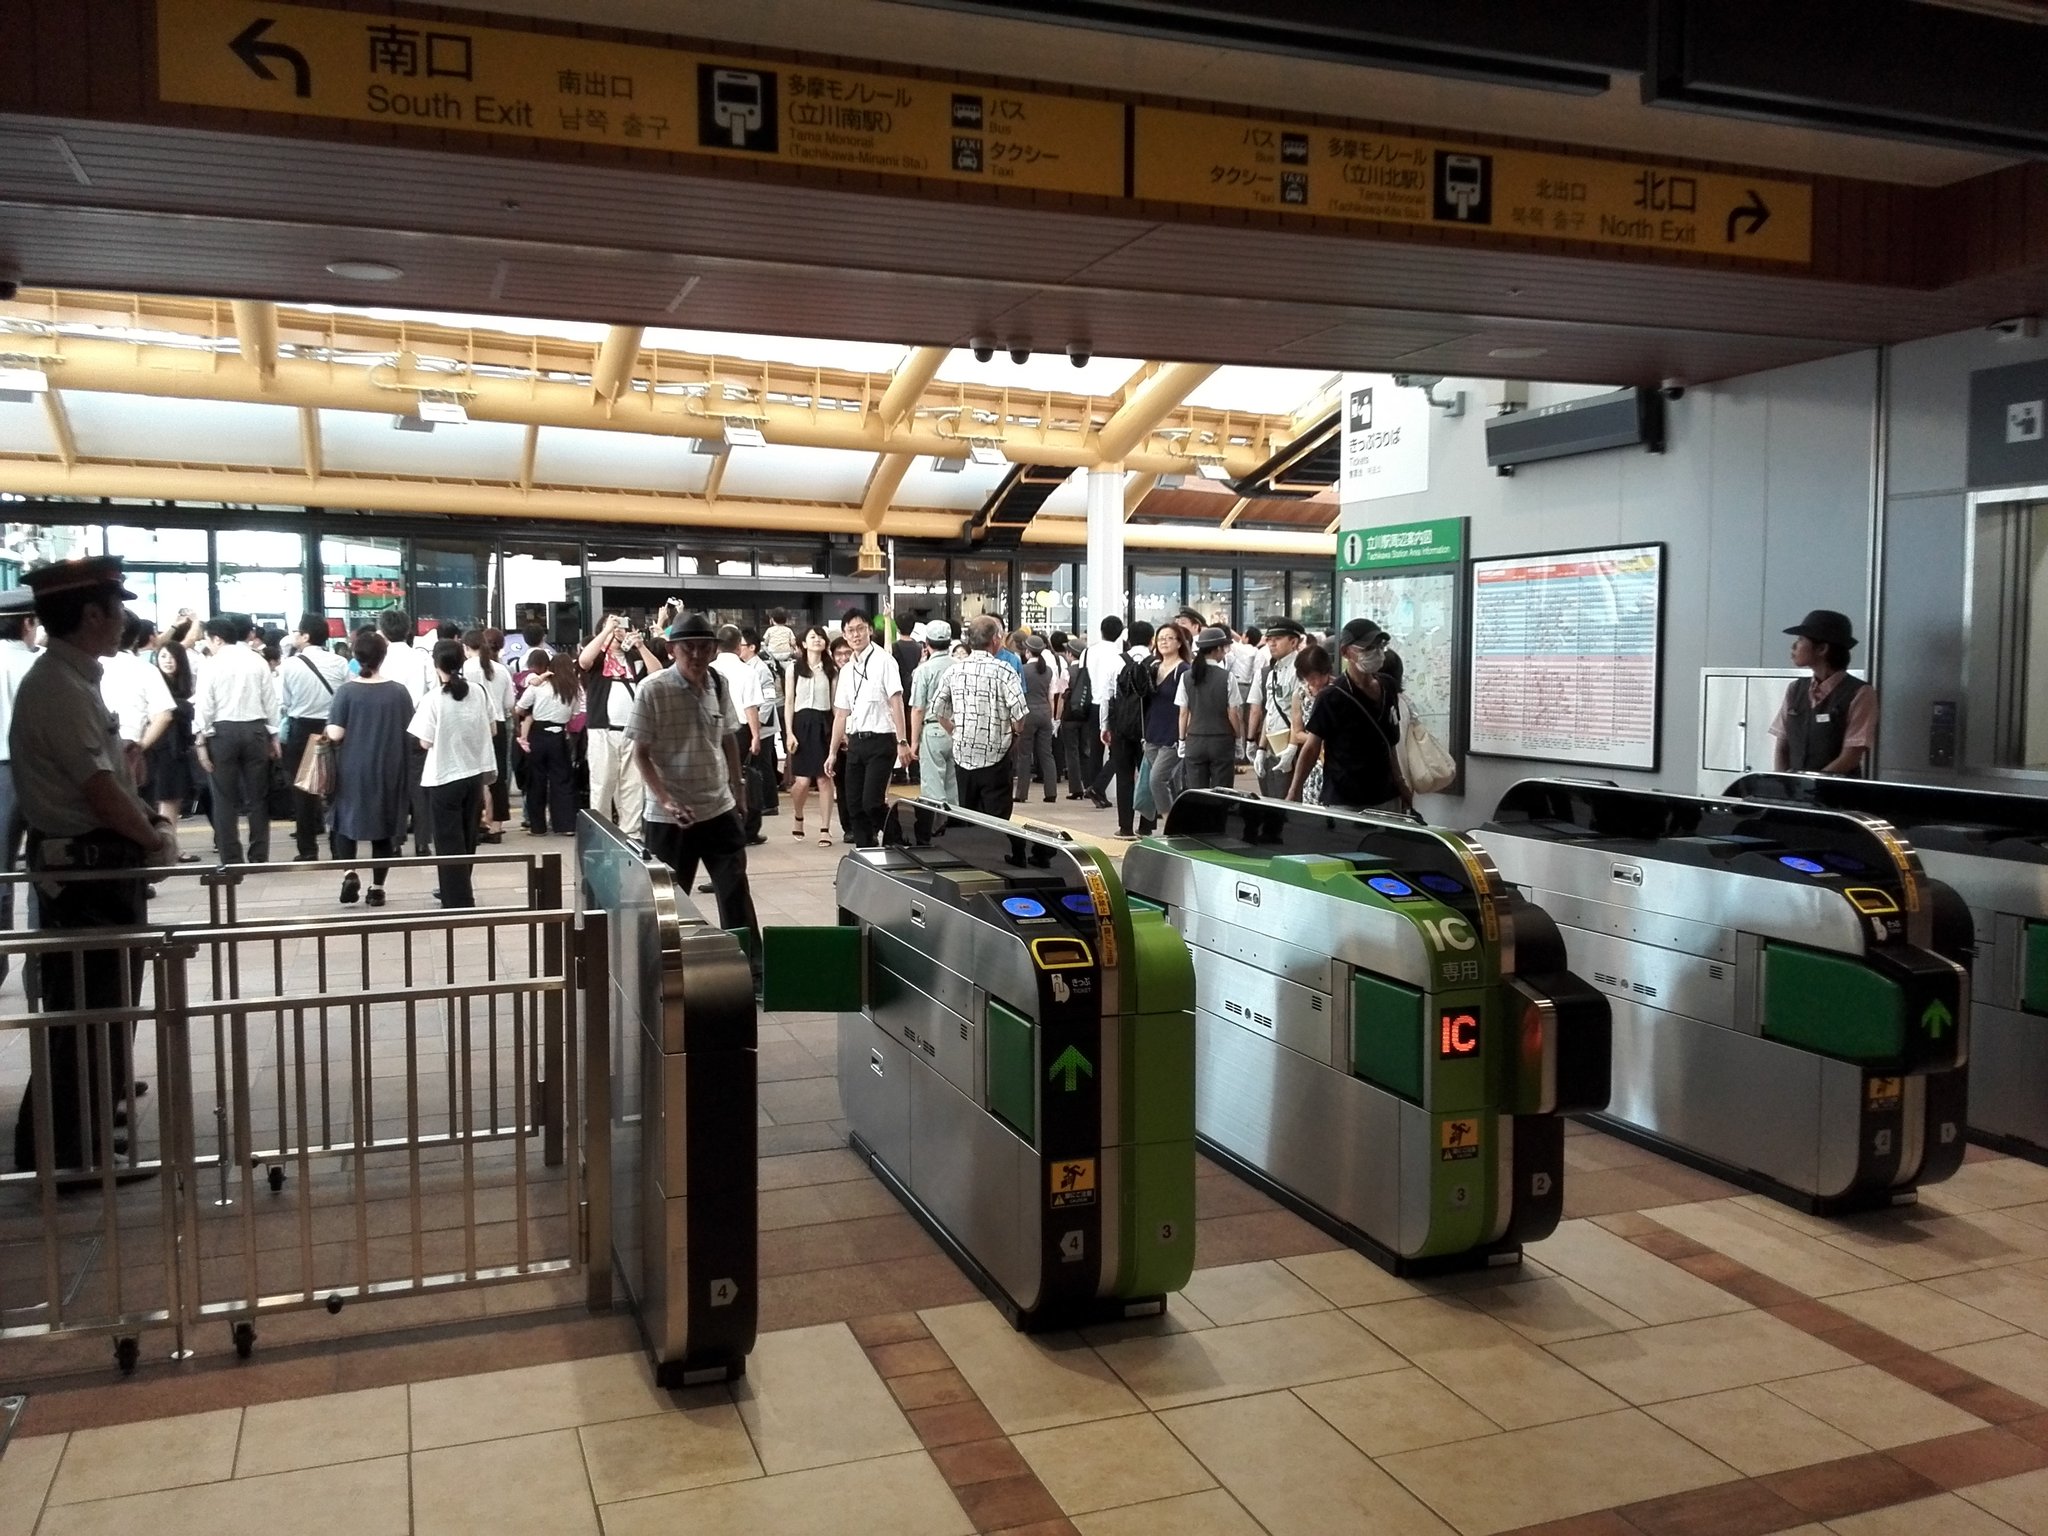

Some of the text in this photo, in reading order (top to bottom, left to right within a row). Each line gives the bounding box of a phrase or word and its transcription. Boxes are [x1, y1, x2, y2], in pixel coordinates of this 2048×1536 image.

[366, 24, 473, 81] 南口
[558, 69, 633, 100] 南出口
[789, 74, 912, 108] 多摩モノレール
[368, 85, 534, 129] South Exit
[789, 101, 892, 133] (立川南駅)
[990, 100, 1026, 121] バス
[560, 107, 671, 140] 남쪽 출구
[989, 122, 1012, 135] Bus
[790, 128, 874, 149] Tama Monorail
[955, 139, 981, 149] TAXI
[1244, 130, 1274, 148] バス
[991, 142, 1060, 162] タクシー
[1329, 137, 1427, 166] 多摩モノレール
[992, 166, 1014, 178] Taxi
[1210, 165, 1274, 186] タクシー
[1536, 177, 1586, 201] 北出口
[1634, 170, 1696, 213] 北口
[1600, 214, 1697, 243] North Exit
[1349, 426, 1401, 453] きっぷうりば
[1422, 917, 1476, 951] IC
[1442, 960, 1479, 982] 専用
[1441, 1015, 1476, 1053] IC
[1457, 1187, 1466, 1201] 3
[1537, 1178, 1545, 1190] 2
[1162, 1225, 1172, 1238] 3
[1069, 1236, 1079, 1250] 4
[717, 1284, 728, 1299] 4
